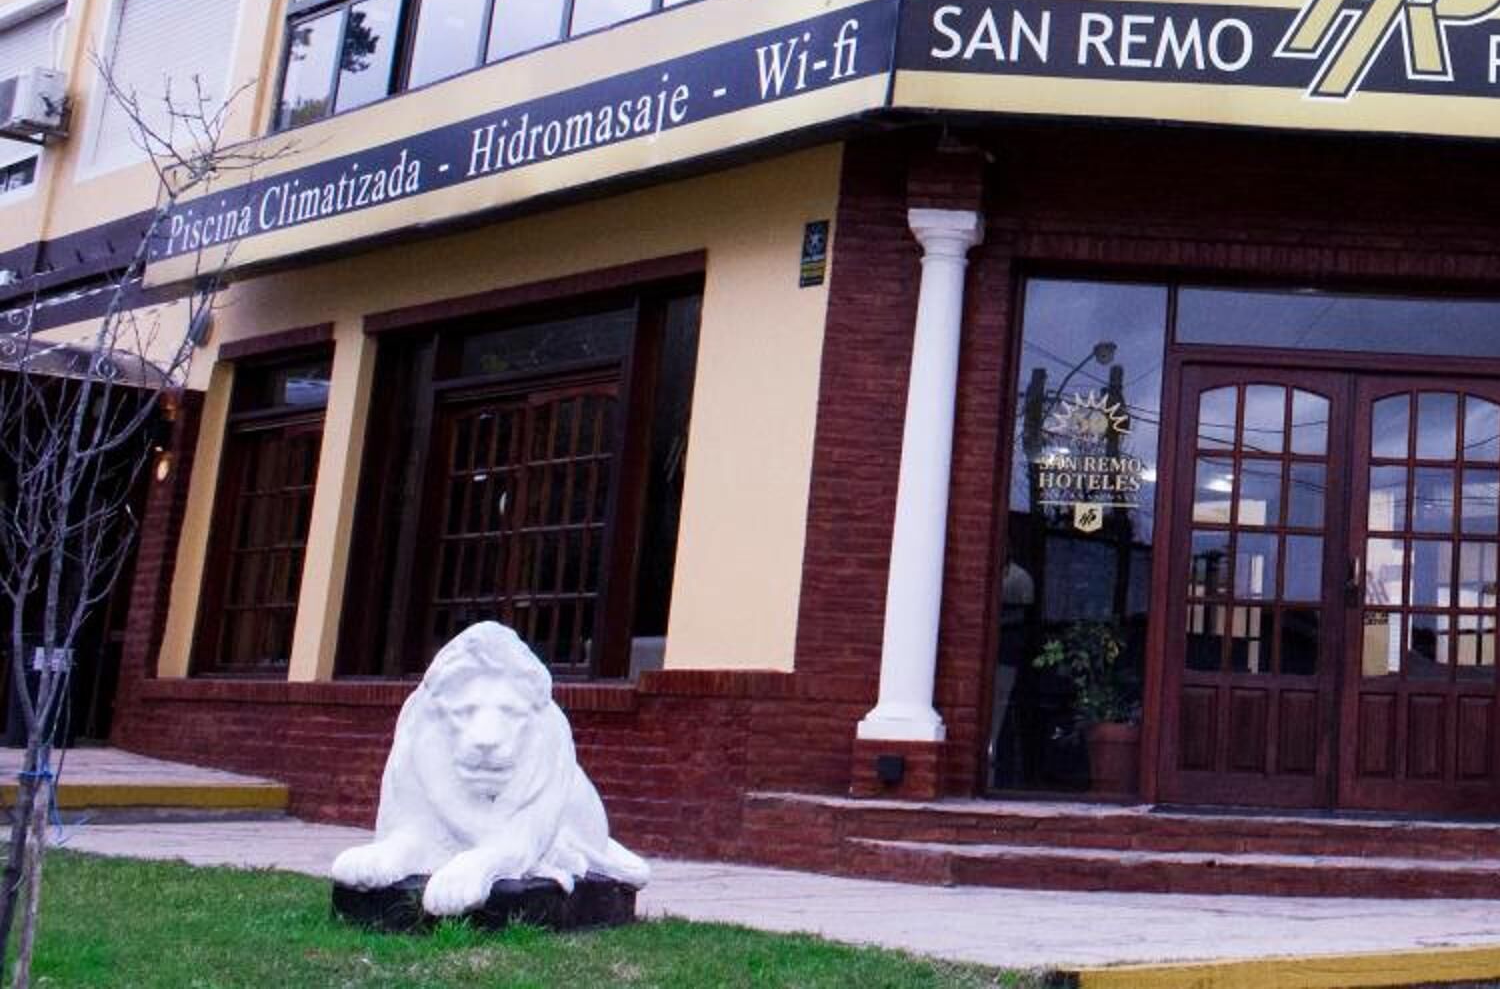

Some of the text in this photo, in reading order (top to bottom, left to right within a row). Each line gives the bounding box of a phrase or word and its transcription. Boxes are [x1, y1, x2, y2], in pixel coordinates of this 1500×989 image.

[931, 6, 1253, 71] SAN REMO
[166, 199, 251, 255] Piscina
[259, 148, 421, 230] Climatizada
[468, 74, 690, 176] Hidromasaje
[755, 19, 859, 99] Wi-fi
[1039, 455, 1142, 473] SAN REMO
[1039, 472, 1141, 492] HOTELES
